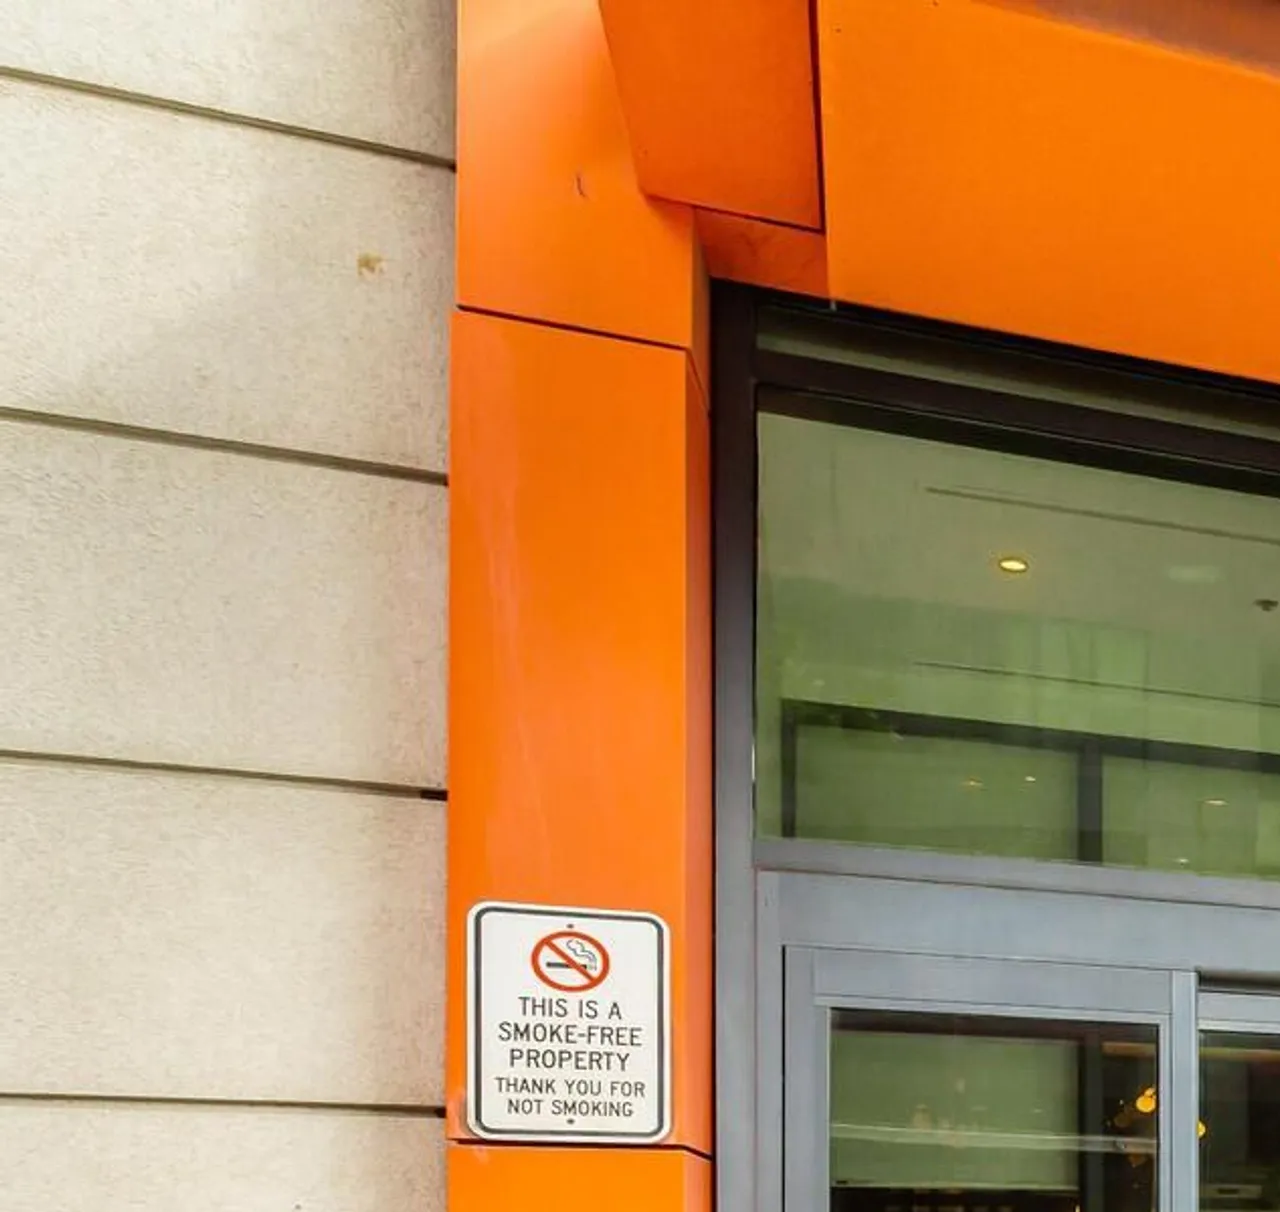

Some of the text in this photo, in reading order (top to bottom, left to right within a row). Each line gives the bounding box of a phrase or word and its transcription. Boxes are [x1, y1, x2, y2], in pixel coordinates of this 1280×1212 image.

[518, 996, 622, 1020] THIS IS A
[498, 1021, 642, 1047] SMOKE-FREE
[509, 1049, 630, 1071] PROPERTY
[495, 1077, 646, 1098] THANK YOU FOR
[507, 1099, 633, 1117] NOT SMOKING
